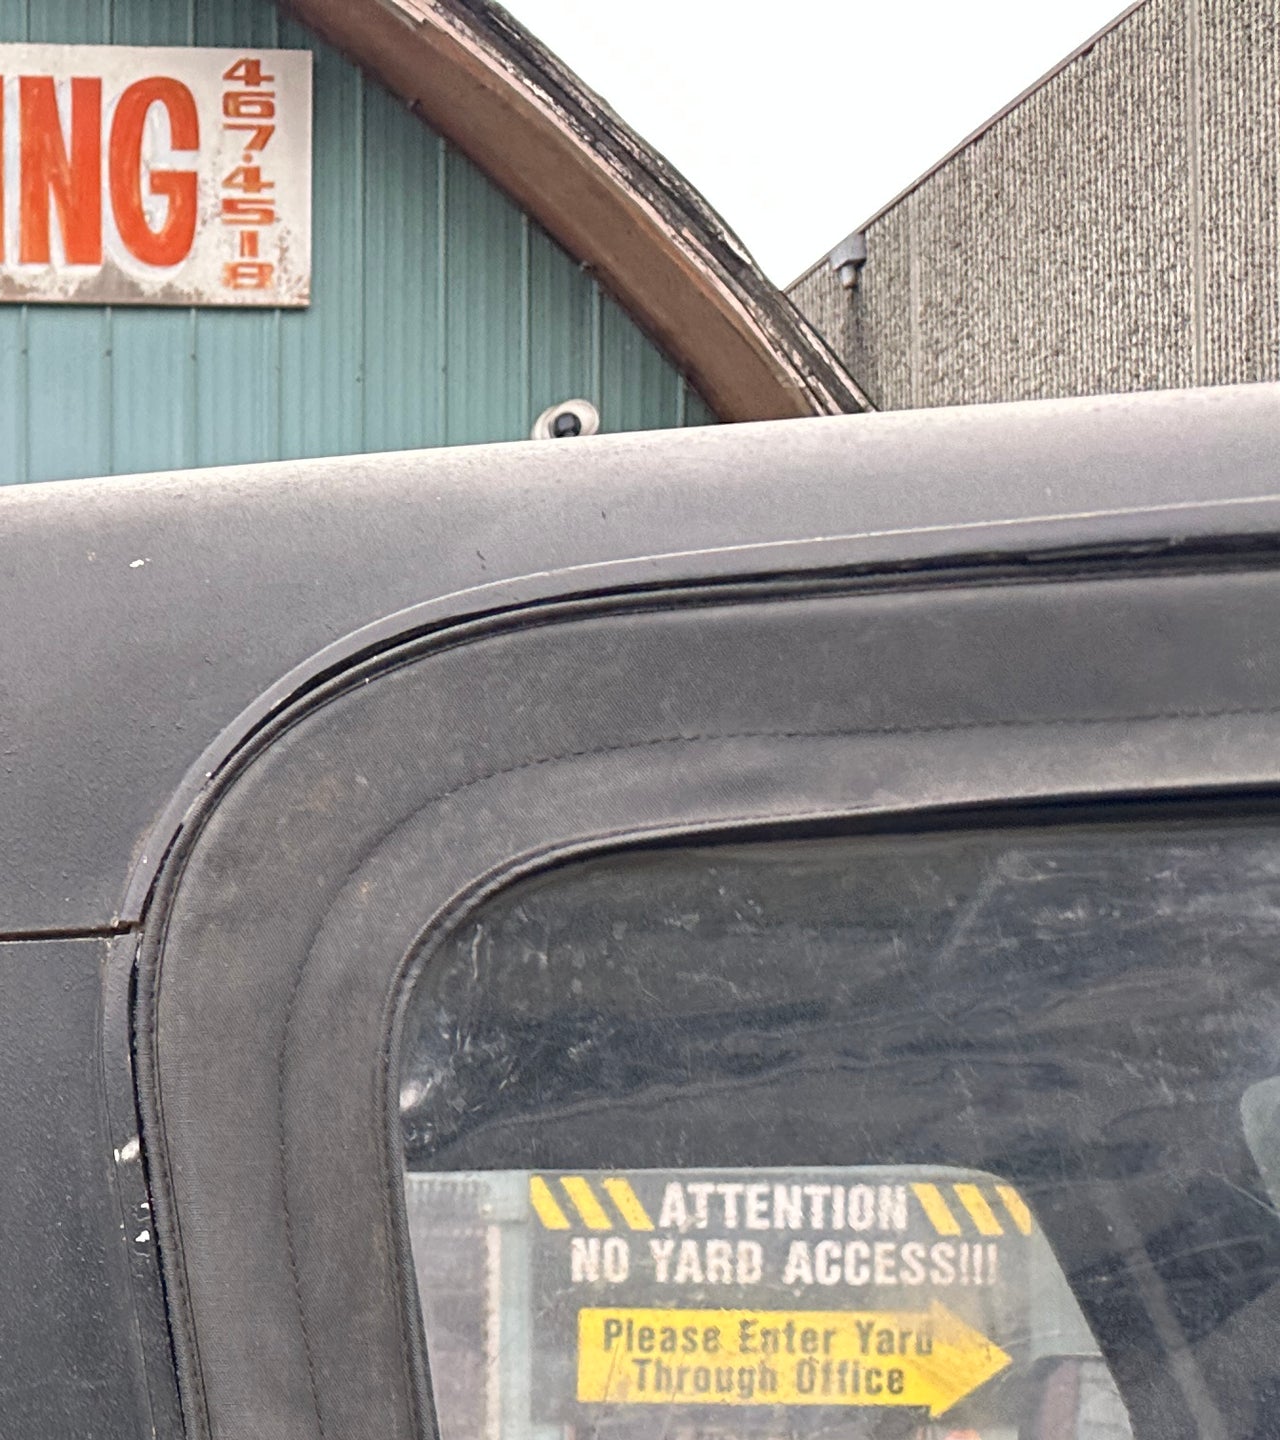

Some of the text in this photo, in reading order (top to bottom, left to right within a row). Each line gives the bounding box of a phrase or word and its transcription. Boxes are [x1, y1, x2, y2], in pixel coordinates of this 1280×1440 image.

[659, 1180, 908, 1231] ATTENTION
[570, 1236, 999, 1287] NO YARD ACCESS!!!
[603, 1317, 935, 1356] Please Enter Yard
[631, 1356, 906, 1399] Through Office
